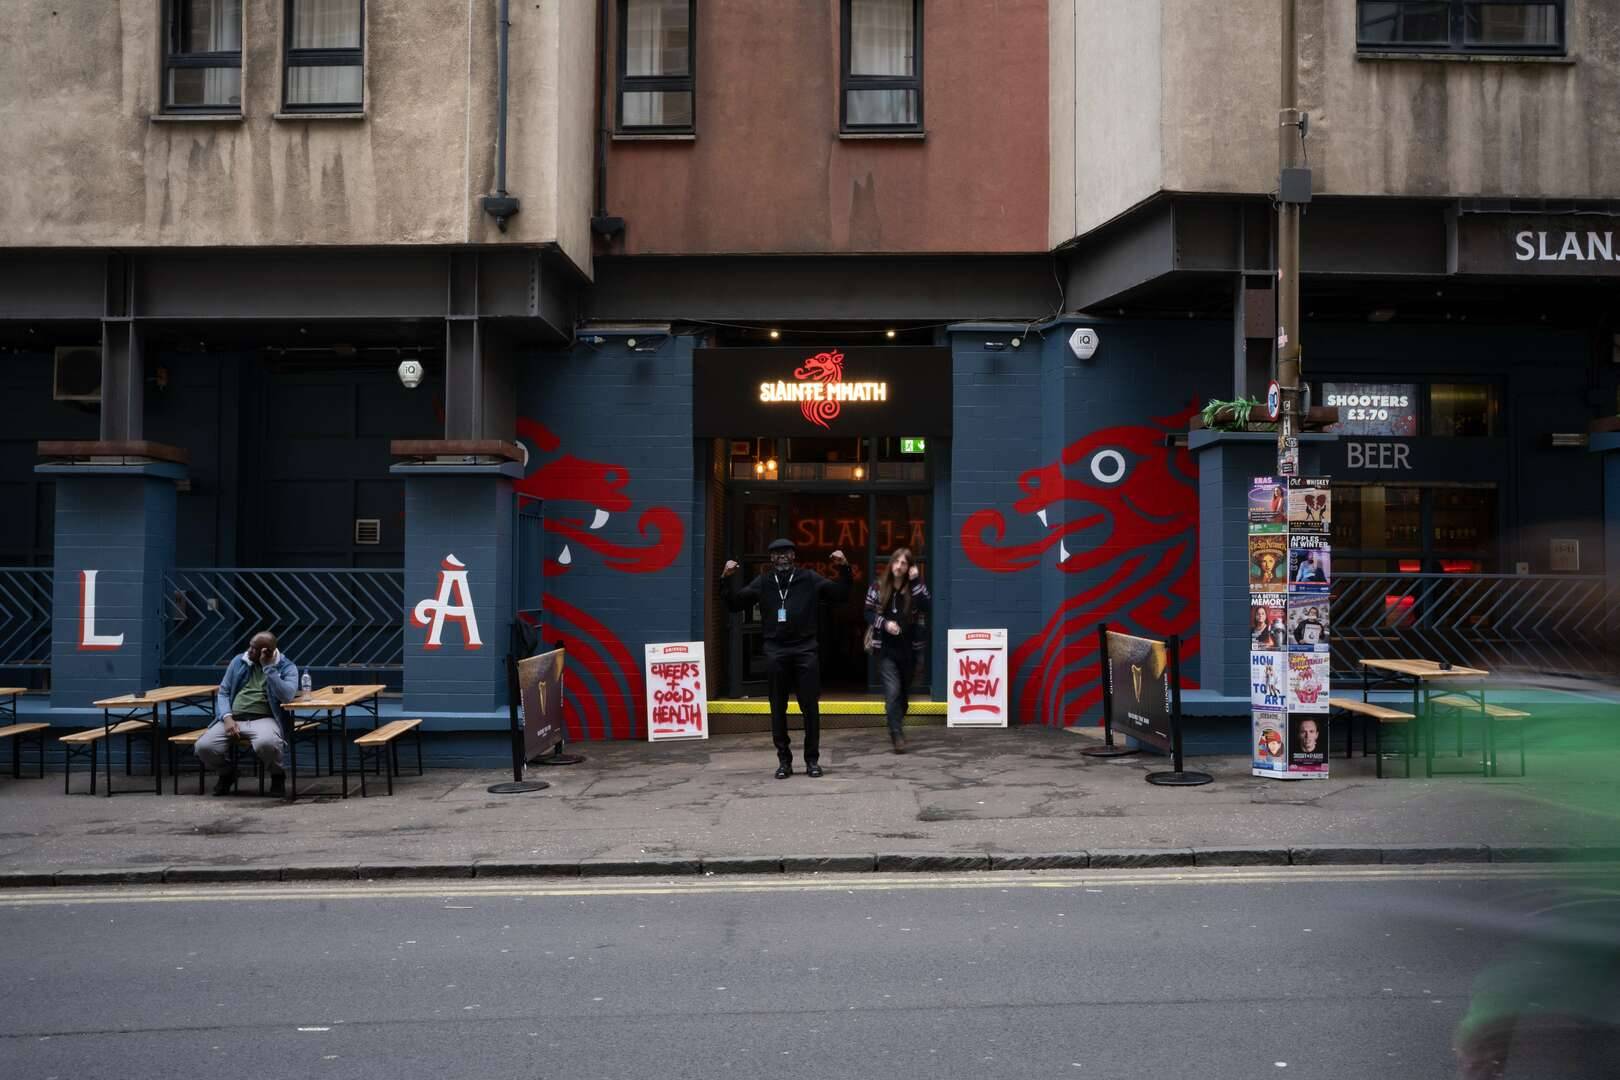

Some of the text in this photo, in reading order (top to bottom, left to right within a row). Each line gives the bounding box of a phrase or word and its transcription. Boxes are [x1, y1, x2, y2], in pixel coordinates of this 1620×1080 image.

[1079, 335, 1091, 345] iQ
[405, 365, 415, 374] iQ
[826, 382, 887, 401] MHATH
[1327, 395, 1409, 407] SHOOTERS
[1347, 409, 1388, 420] £3.70
[1347, 442, 1413, 469] BEER
[77, 569, 124, 650] L
[958, 654, 995, 679] NOW
[1252, 656, 1274, 666] HOW
[651, 663, 699, 680] CHEERS
[952, 678, 999, 704] OPEN
[1253, 683, 1267, 693] TO
[654, 690, 695, 704] GOOD
[1264, 695, 1286, 705] ART
[652, 704, 702, 731] HEALTH
